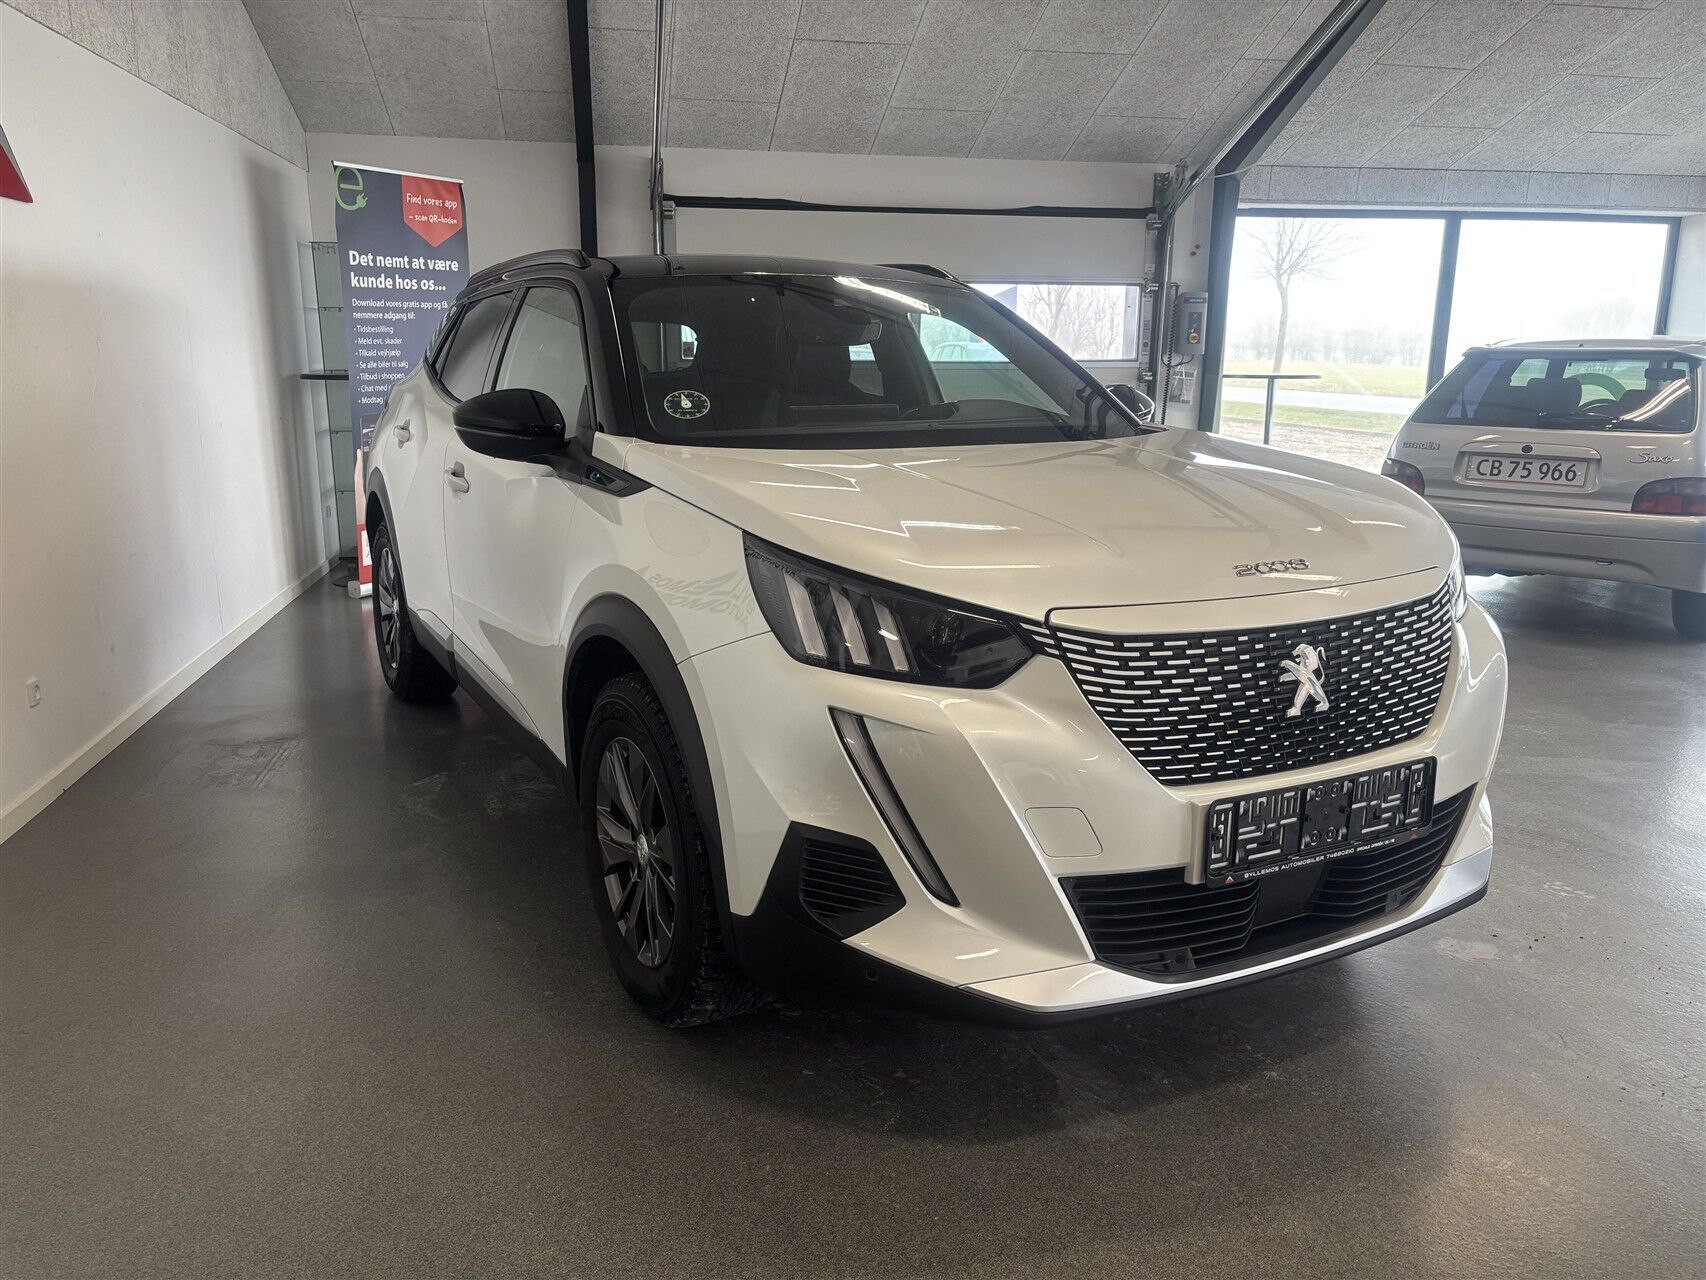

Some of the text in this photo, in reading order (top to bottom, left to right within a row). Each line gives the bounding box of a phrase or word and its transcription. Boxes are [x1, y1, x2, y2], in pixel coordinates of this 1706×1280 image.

[406, 193, 458, 210] Find vores app
[415, 214, 428, 222] scan
[429, 214, 458, 225] QR-koden
[348, 250, 459, 272] Det nemt at være
[350, 272, 446, 291] kunde hos os...
[352, 298, 448, 310] Download vores gratis app og få
[384, 312, 407, 321] adgang
[407, 312, 416, 320] til:
[357, 325, 394, 334] Tidsbestilling
[358, 337, 372, 345] Meld
[384, 337, 402, 345] skader
[358, 349, 401, 358] Tilkald vejhjælp
[359, 361, 367, 369] Se
[367, 361, 378, 369] alle
[378, 360, 391, 368] biler
[398, 360, 409, 369] salg
[359, 372, 378, 380] Tilbud
[361, 384, 374, 392] Chat
[375, 384, 388, 392] med
[361, 397, 384, 405] Modtag
[1402, 440, 1441, 450] CITROËN
[1629, 452, 1680, 465] Saxo
[1476, 459, 1577, 482] CB 75 966
[1232, 558, 1311, 577] 2008
[1244, 866, 1280, 879] BYLLEMOS
[1280, 855, 1325, 870] AUTOMOBILER
